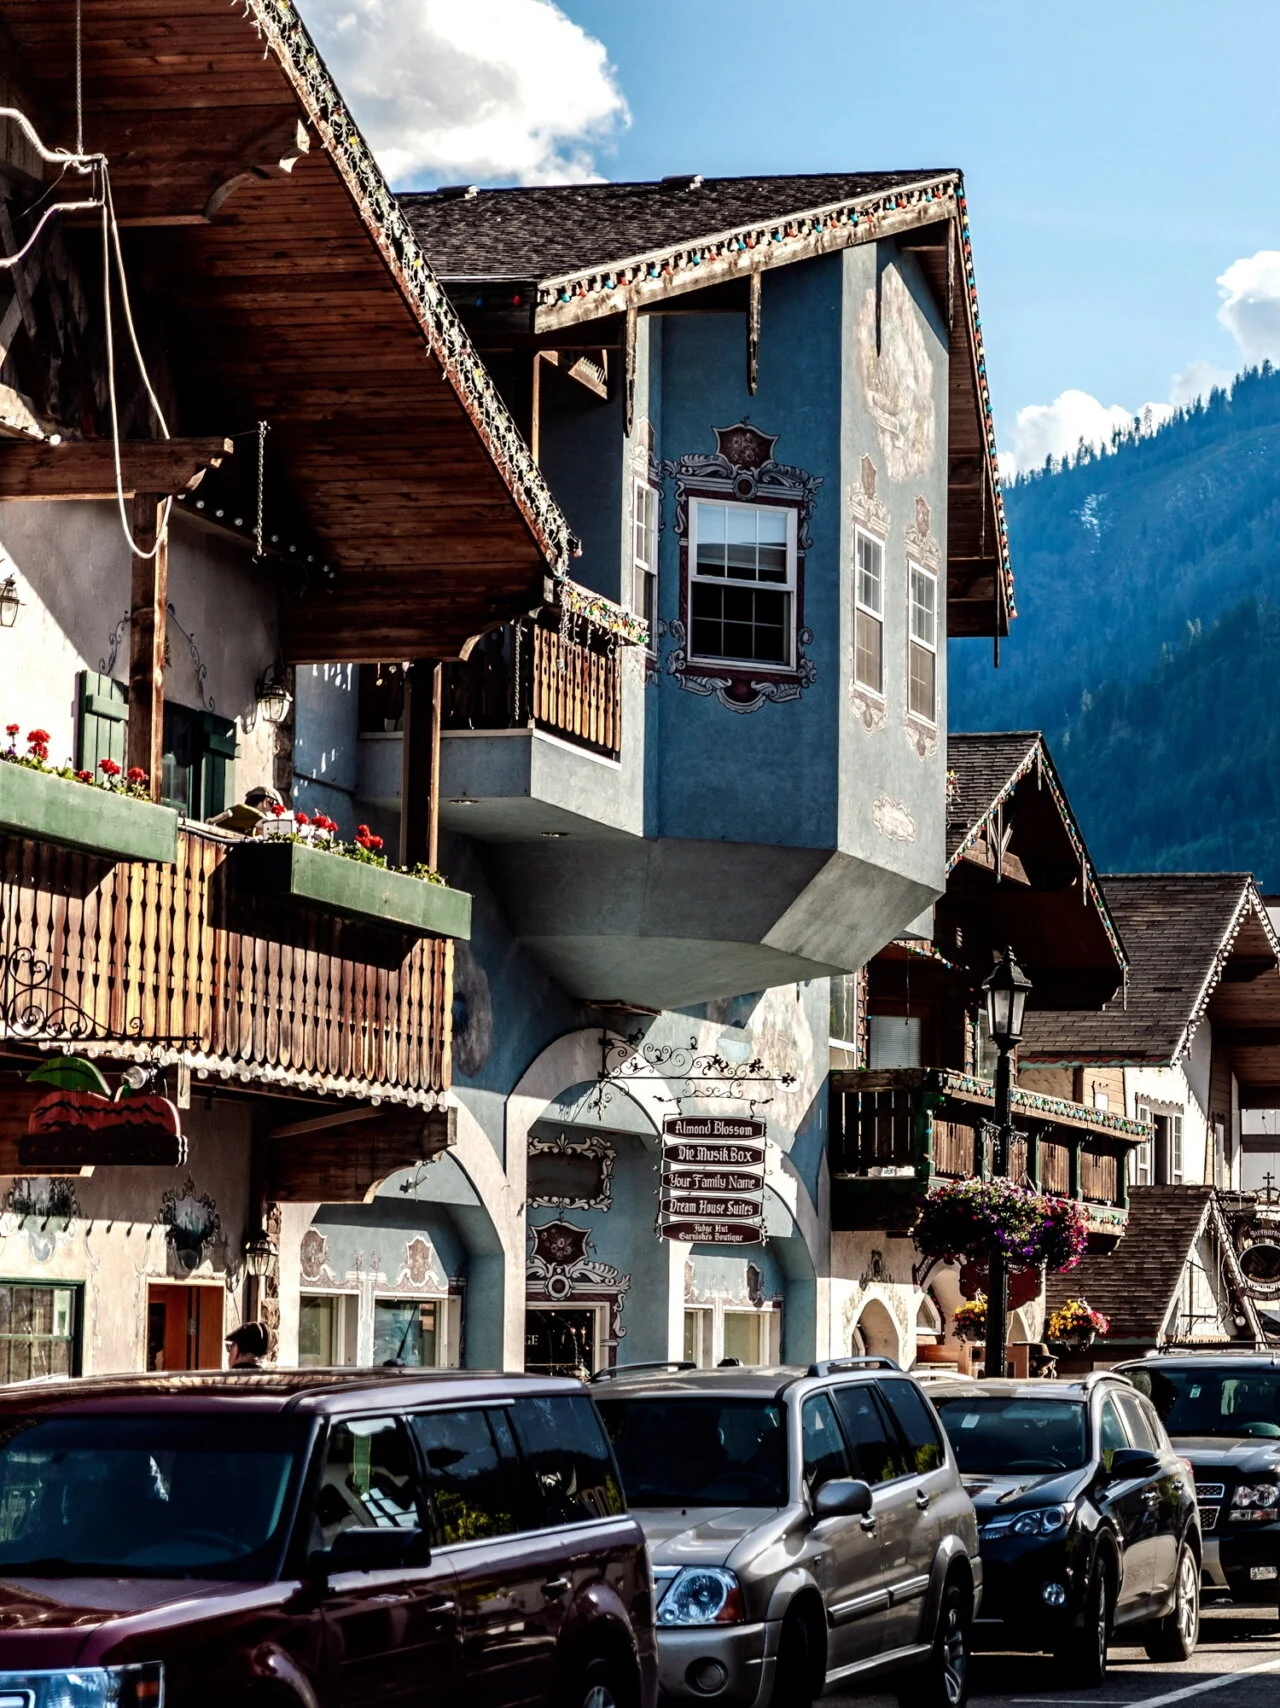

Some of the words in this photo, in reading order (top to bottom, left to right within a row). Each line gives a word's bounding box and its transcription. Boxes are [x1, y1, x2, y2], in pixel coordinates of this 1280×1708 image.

[675, 1120, 711, 1134] Almond
[713, 1120, 753, 1136] Blossom
[677, 1145, 695, 1160] Die
[695, 1146, 729, 1161] Musik
[730, 1148, 753, 1162] Box
[669, 1174, 692, 1187] Your
[693, 1173, 726, 1189] Family
[728, 1175, 755, 1189] Name
[669, 1200, 696, 1213] Dream
[698, 1201, 725, 1214] House
[727, 1201, 754, 1215] Suites
[693, 1223, 713, 1234] Fudge
[715, 1224, 728, 1233] Hut
[714, 1233, 743, 1242] Boutique
